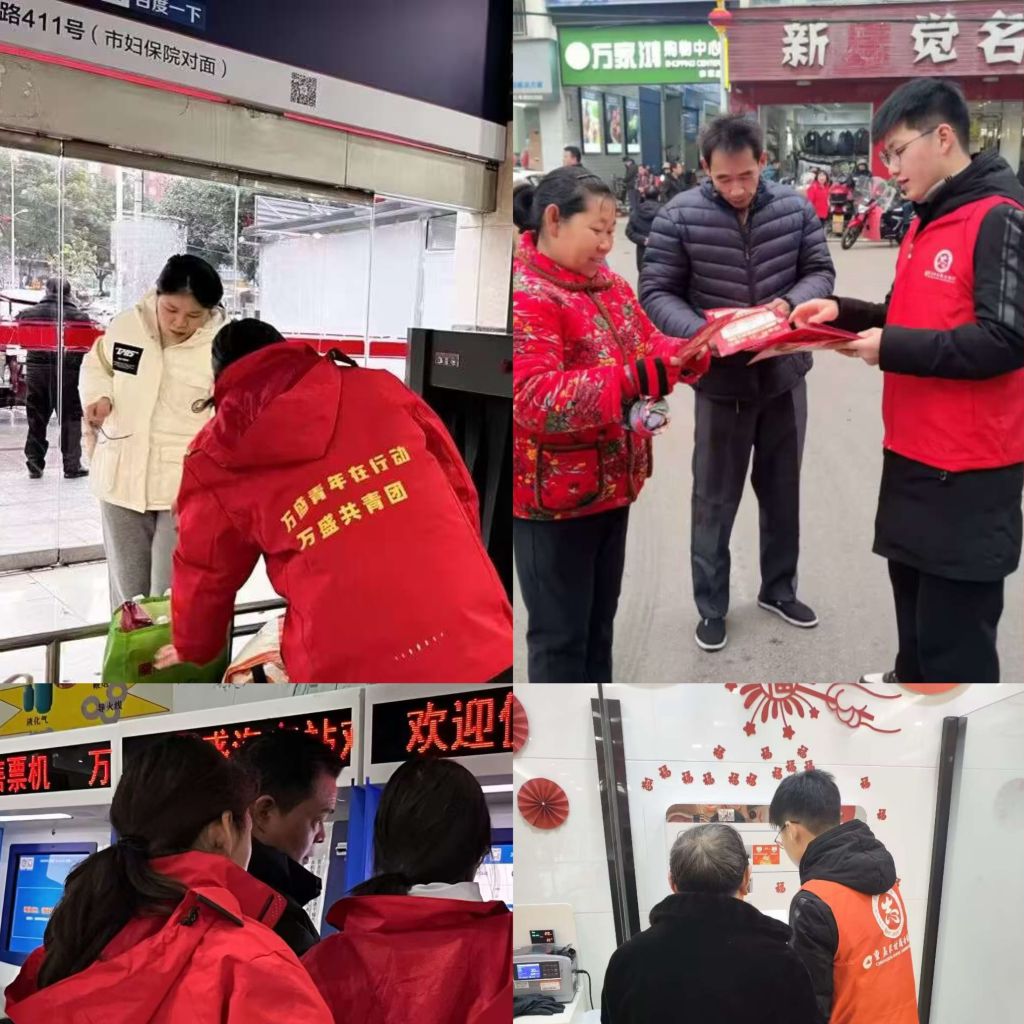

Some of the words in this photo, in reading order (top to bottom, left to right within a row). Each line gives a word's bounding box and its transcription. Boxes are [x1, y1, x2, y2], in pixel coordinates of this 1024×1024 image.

[280, 445, 411, 533] 万盛青年在行动
[296, 480, 408, 550] 万盛共青团
